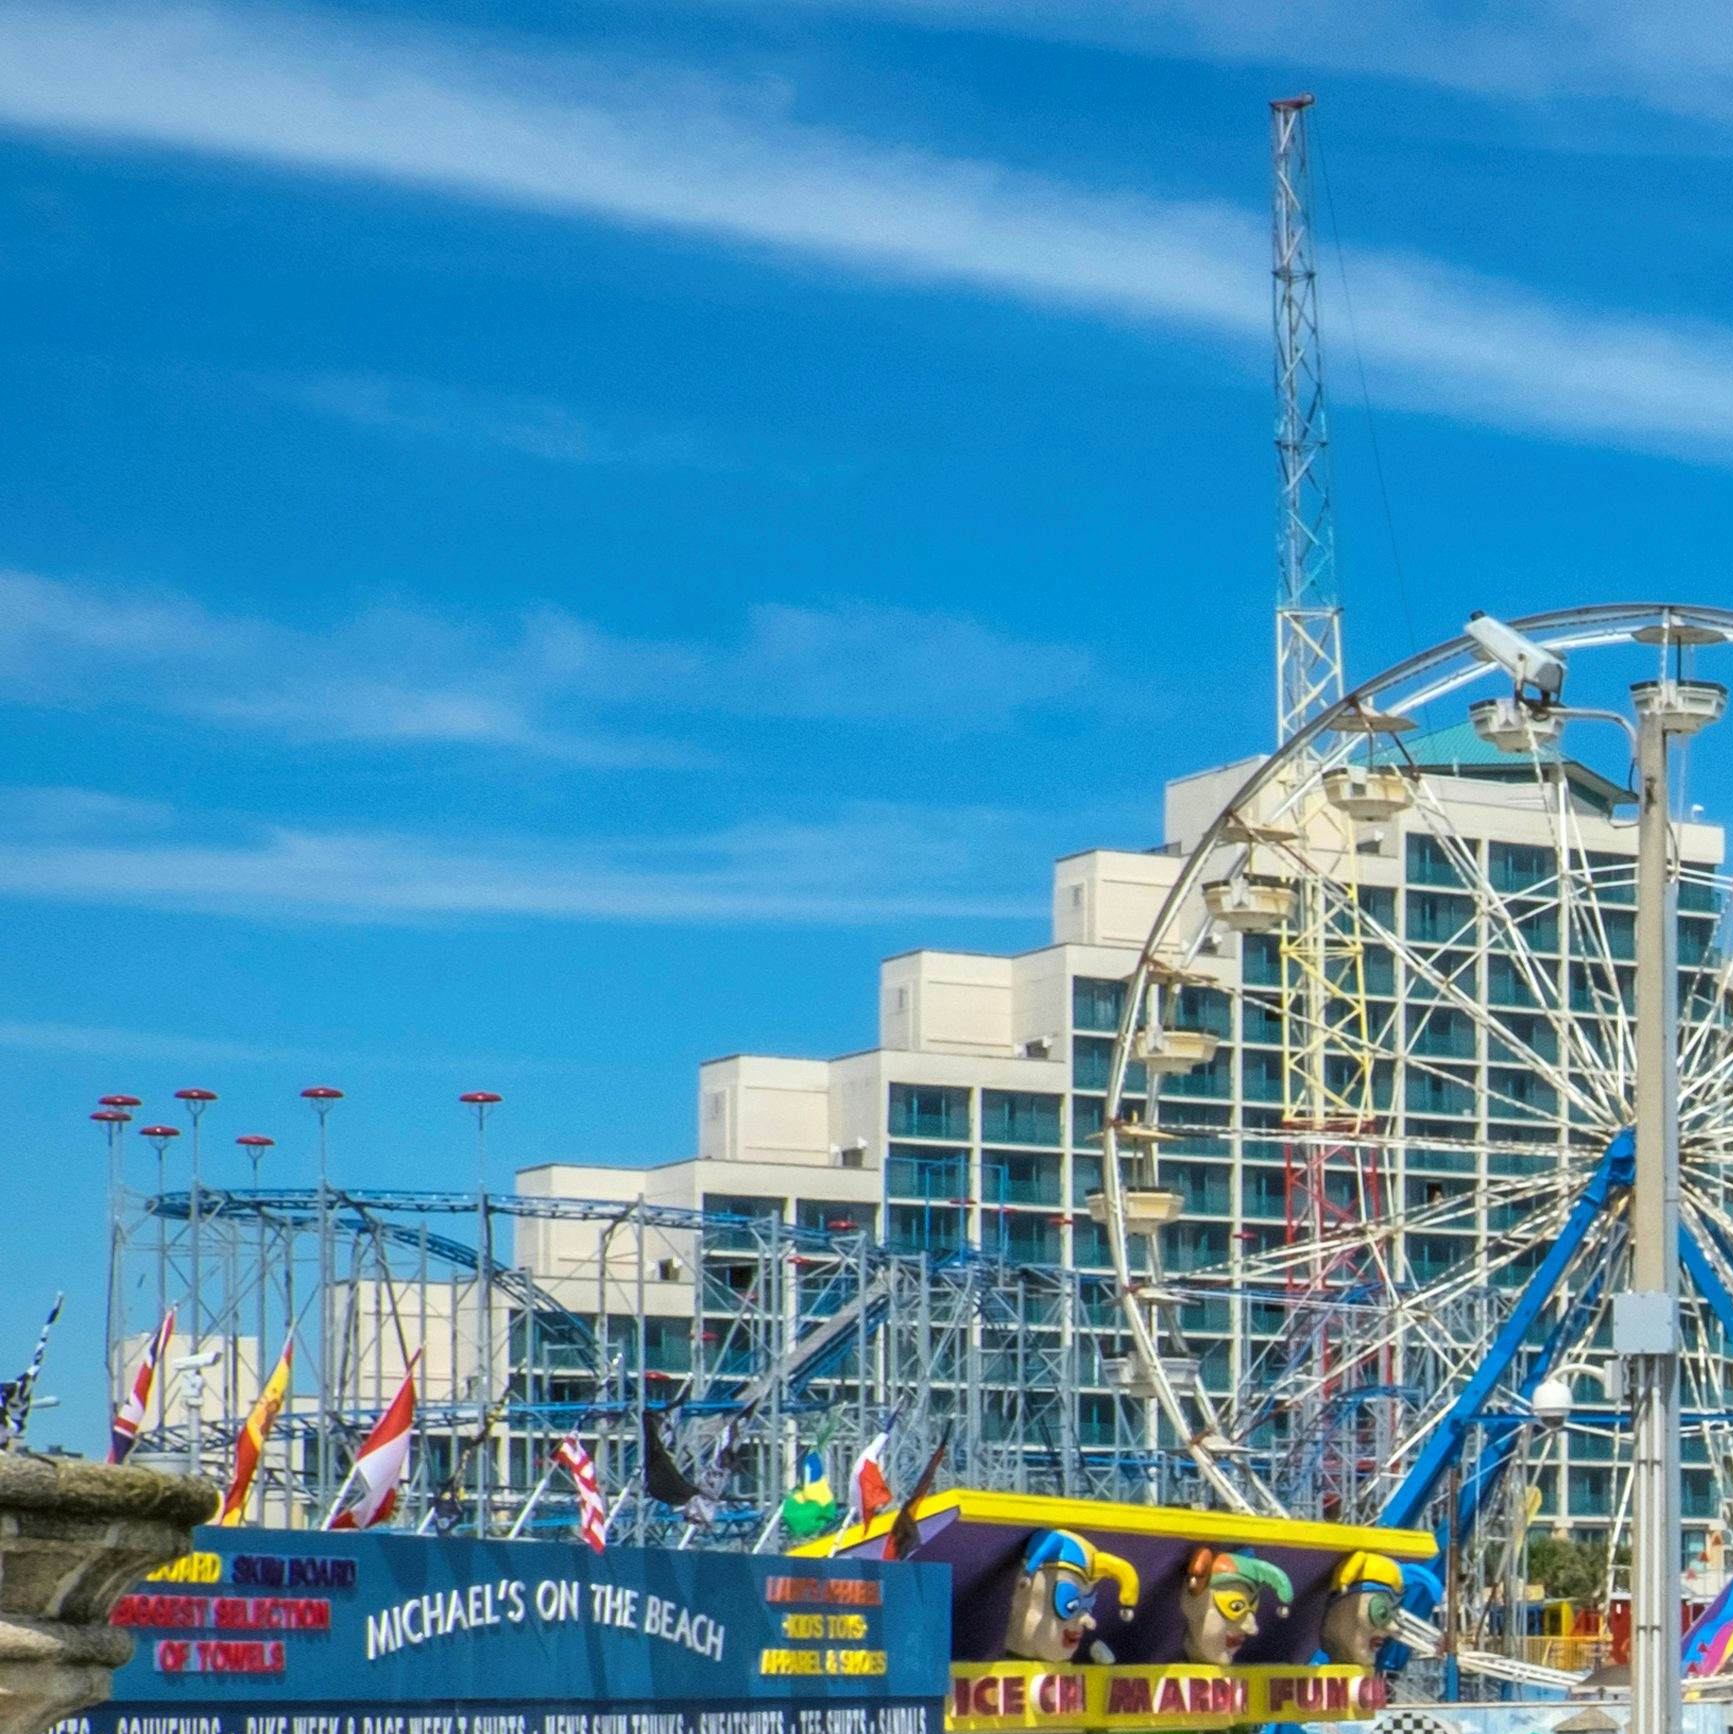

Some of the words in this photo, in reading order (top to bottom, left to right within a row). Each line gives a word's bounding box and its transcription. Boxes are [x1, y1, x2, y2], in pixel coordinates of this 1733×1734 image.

[212, 1596, 331, 1631] SELECTION
[367, 1578, 527, 1661] MICHAEL'S
[536, 1579, 580, 1622] ON
[590, 1583, 639, 1629] THE
[644, 1594, 726, 1663] BEACH
[159, 1639, 191, 1673] OF
[196, 1640, 285, 1673] TOWELS
[825, 1649, 838, 1676] &
[952, 1675, 1026, 1717] ICE
[1269, 1676, 1350, 1713] FUN
